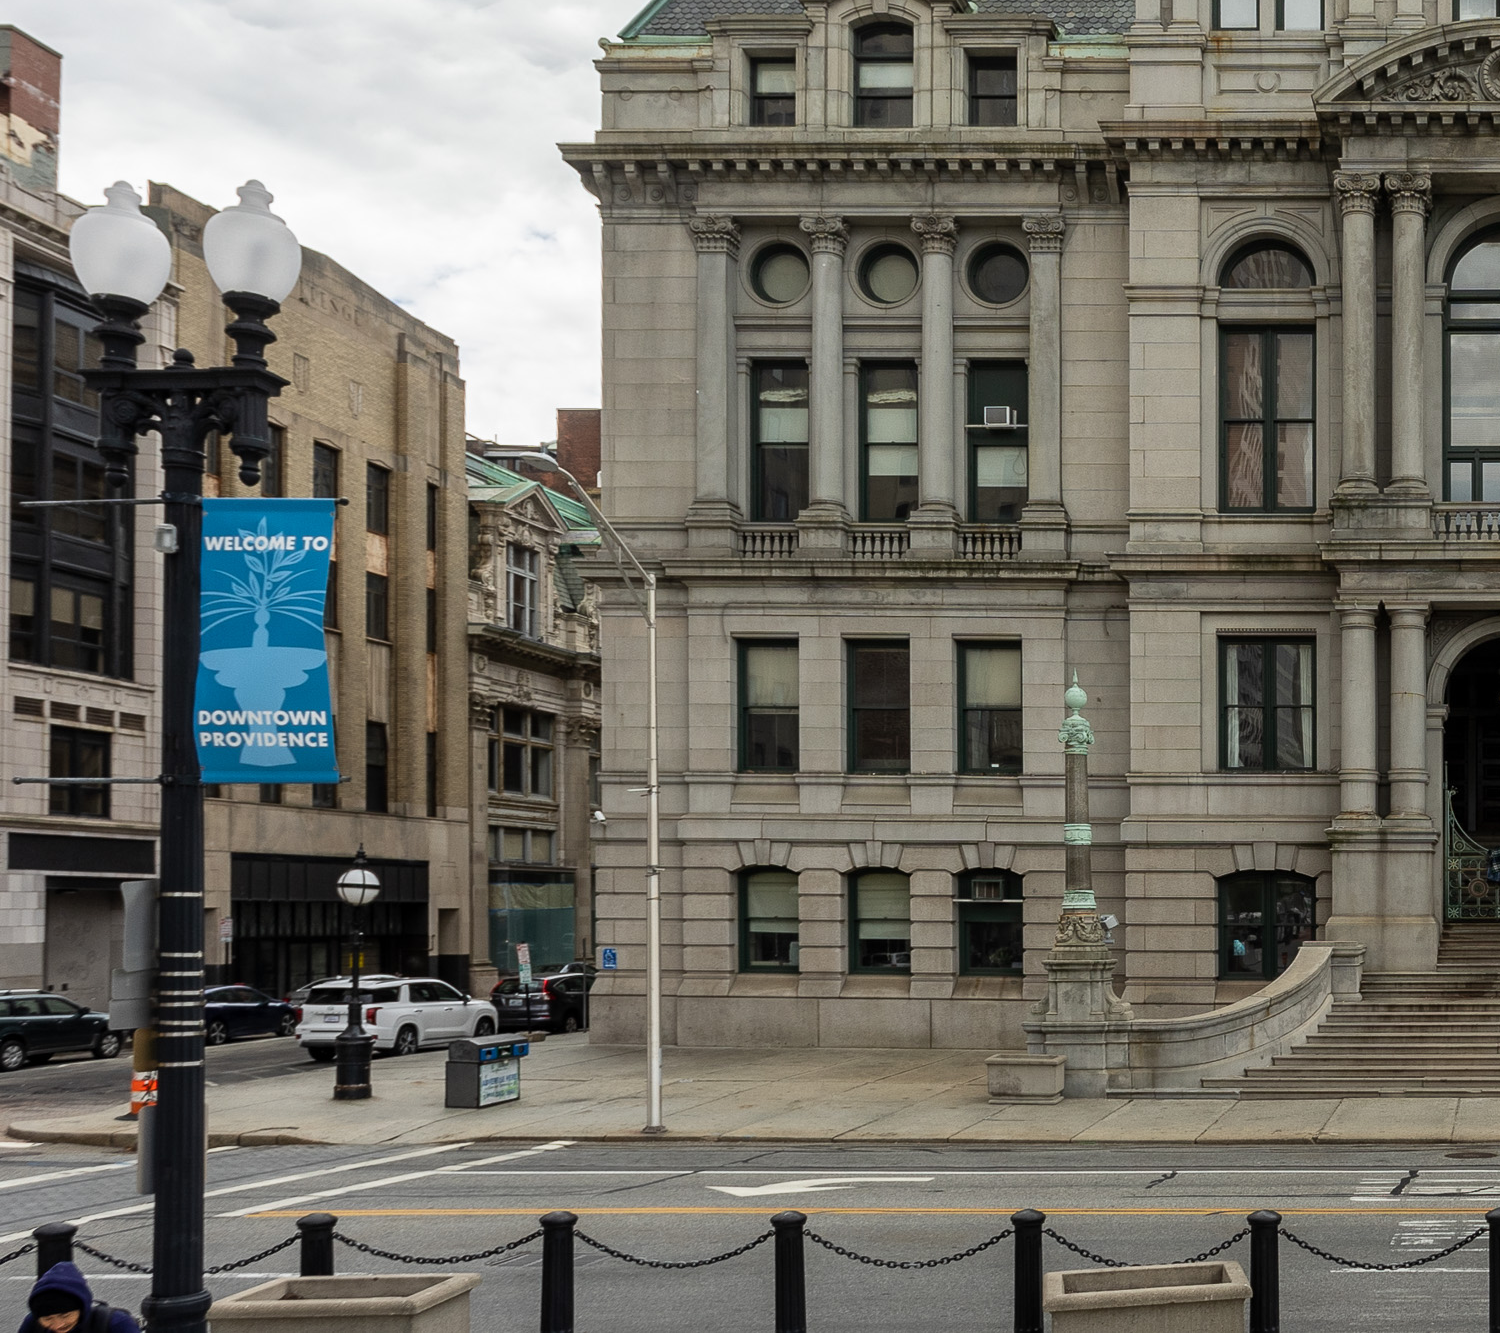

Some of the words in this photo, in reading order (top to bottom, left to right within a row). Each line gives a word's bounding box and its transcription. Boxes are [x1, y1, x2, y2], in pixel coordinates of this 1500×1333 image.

[204, 536, 296, 551] WELCOME
[302, 536, 329, 551] TO
[199, 710, 327, 726] DOWNTOWN
[199, 732, 329, 748] PROVIDENCE
